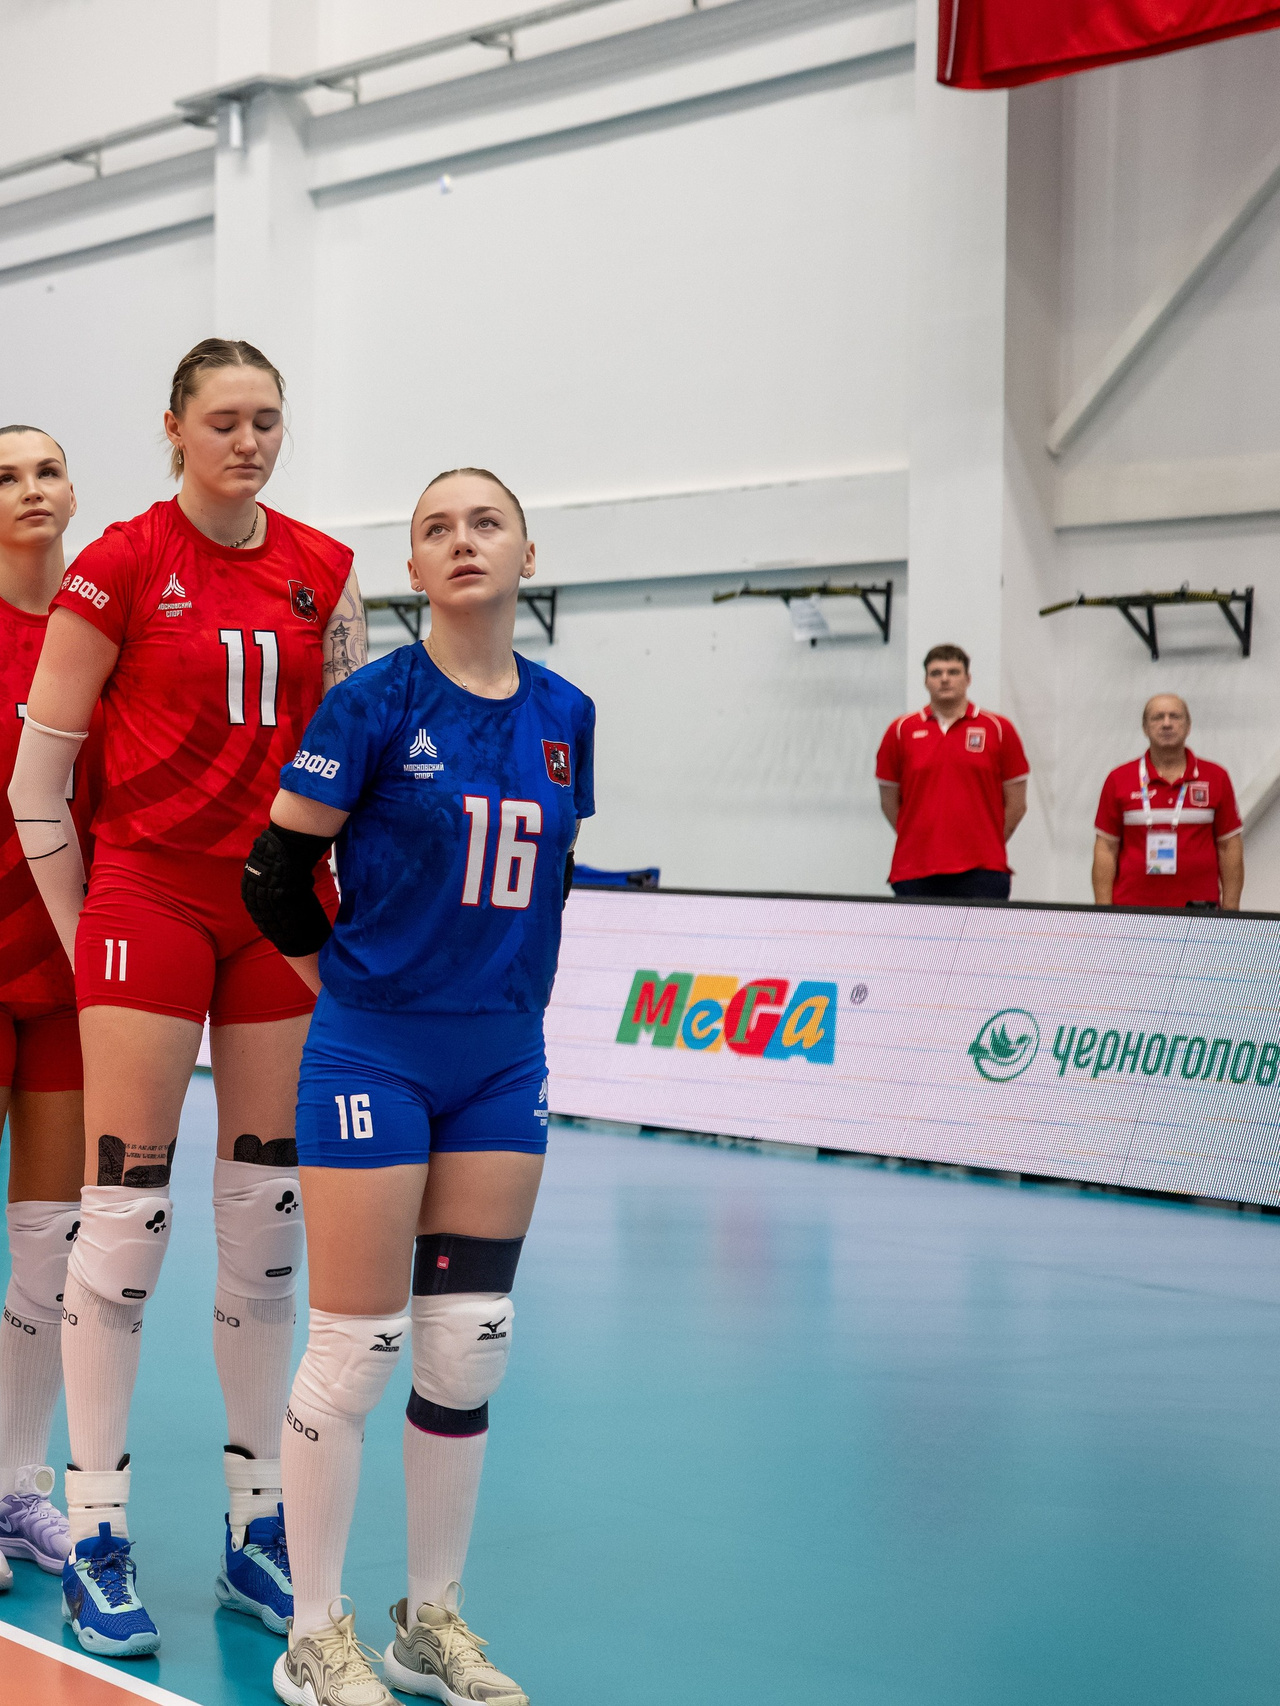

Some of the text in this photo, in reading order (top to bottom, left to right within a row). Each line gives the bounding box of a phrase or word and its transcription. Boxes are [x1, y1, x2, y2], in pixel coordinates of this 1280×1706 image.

[68, 575, 110, 609] ВФВ
[218, 628, 278, 727] 11
[293, 750, 341, 779] ВФВ
[403, 762, 445, 771] МОСКОВСКИЙ
[461, 794, 543, 910] 16
[105, 939, 128, 981] 11
[1052, 1025, 1280, 1087] черноголов
[334, 1093, 373, 1139] 16
[4, 1305, 36, 1335] EDO
[286, 1403, 319, 1442] EDO
